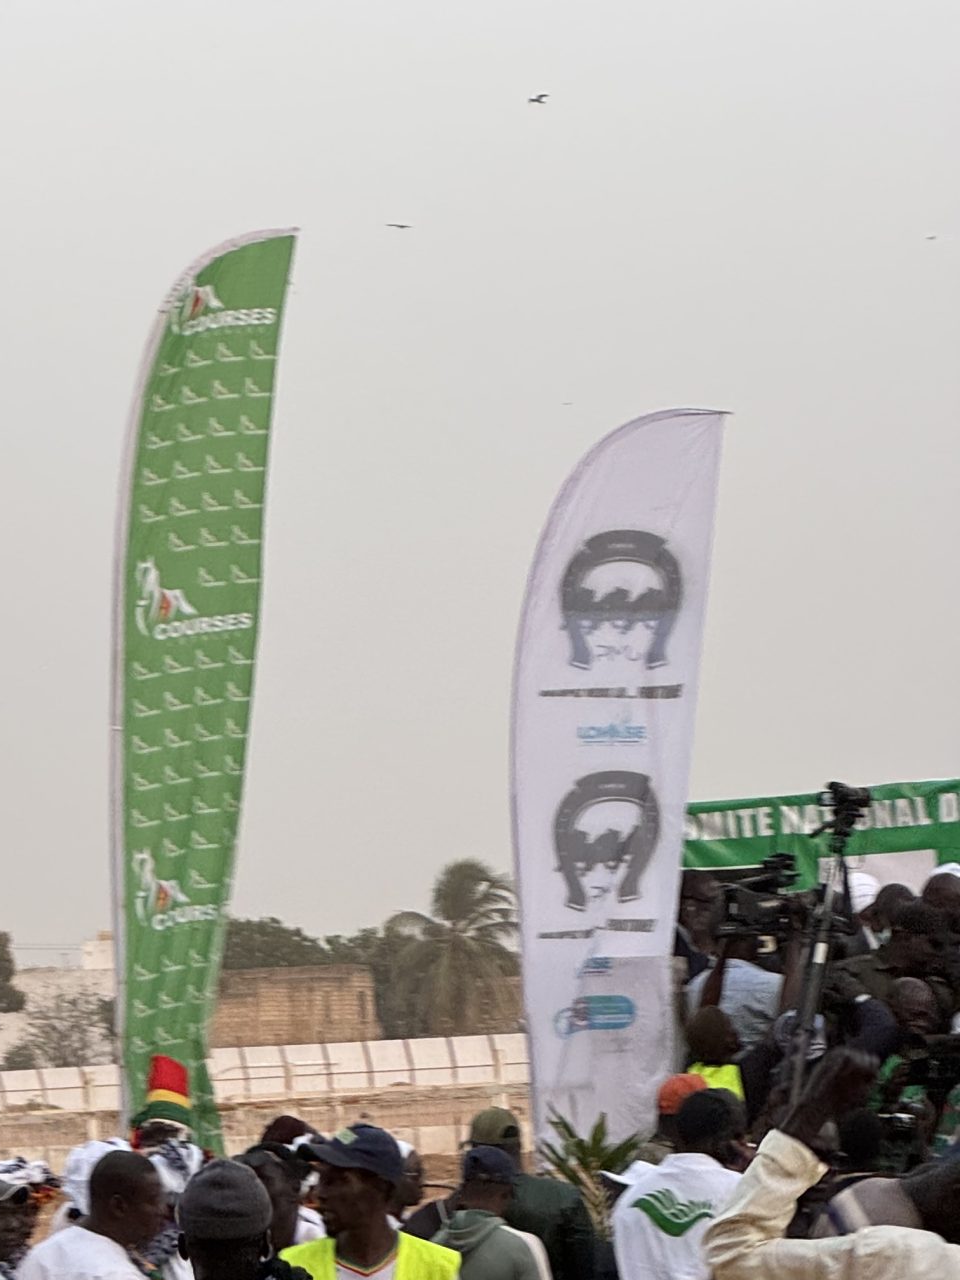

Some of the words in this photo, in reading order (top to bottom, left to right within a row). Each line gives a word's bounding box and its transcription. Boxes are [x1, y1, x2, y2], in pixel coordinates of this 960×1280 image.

[181, 308, 277, 336] COURSES
[153, 612, 253, 640] COURSES
[779, 796, 933, 835] NATONAL
